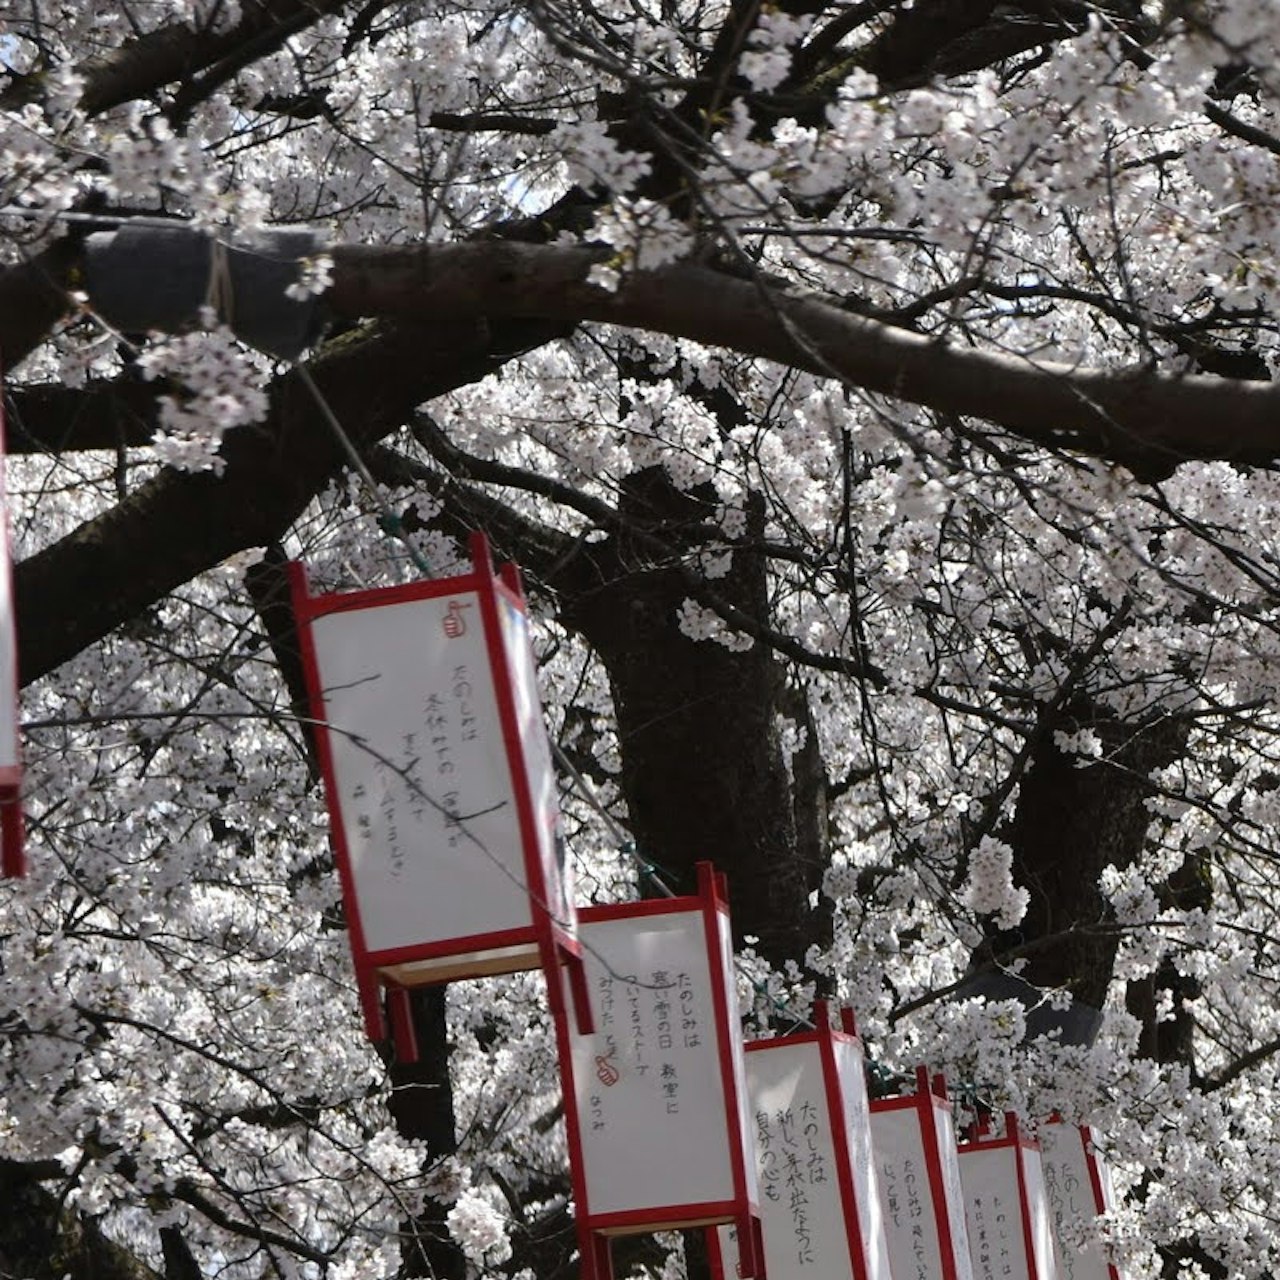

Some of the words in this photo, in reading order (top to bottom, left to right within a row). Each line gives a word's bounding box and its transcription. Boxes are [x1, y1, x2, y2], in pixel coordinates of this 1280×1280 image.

[650, 970, 674, 1049] 寒い雪の日
[676, 972, 702, 1048] たのしみは
[660, 1062, 680, 1115] 教室に
[755, 1112, 781, 1202] 自分の心も
[798, 1104, 828, 1183] たのしみは
[902, 1159, 923, 1218] たのしみは
